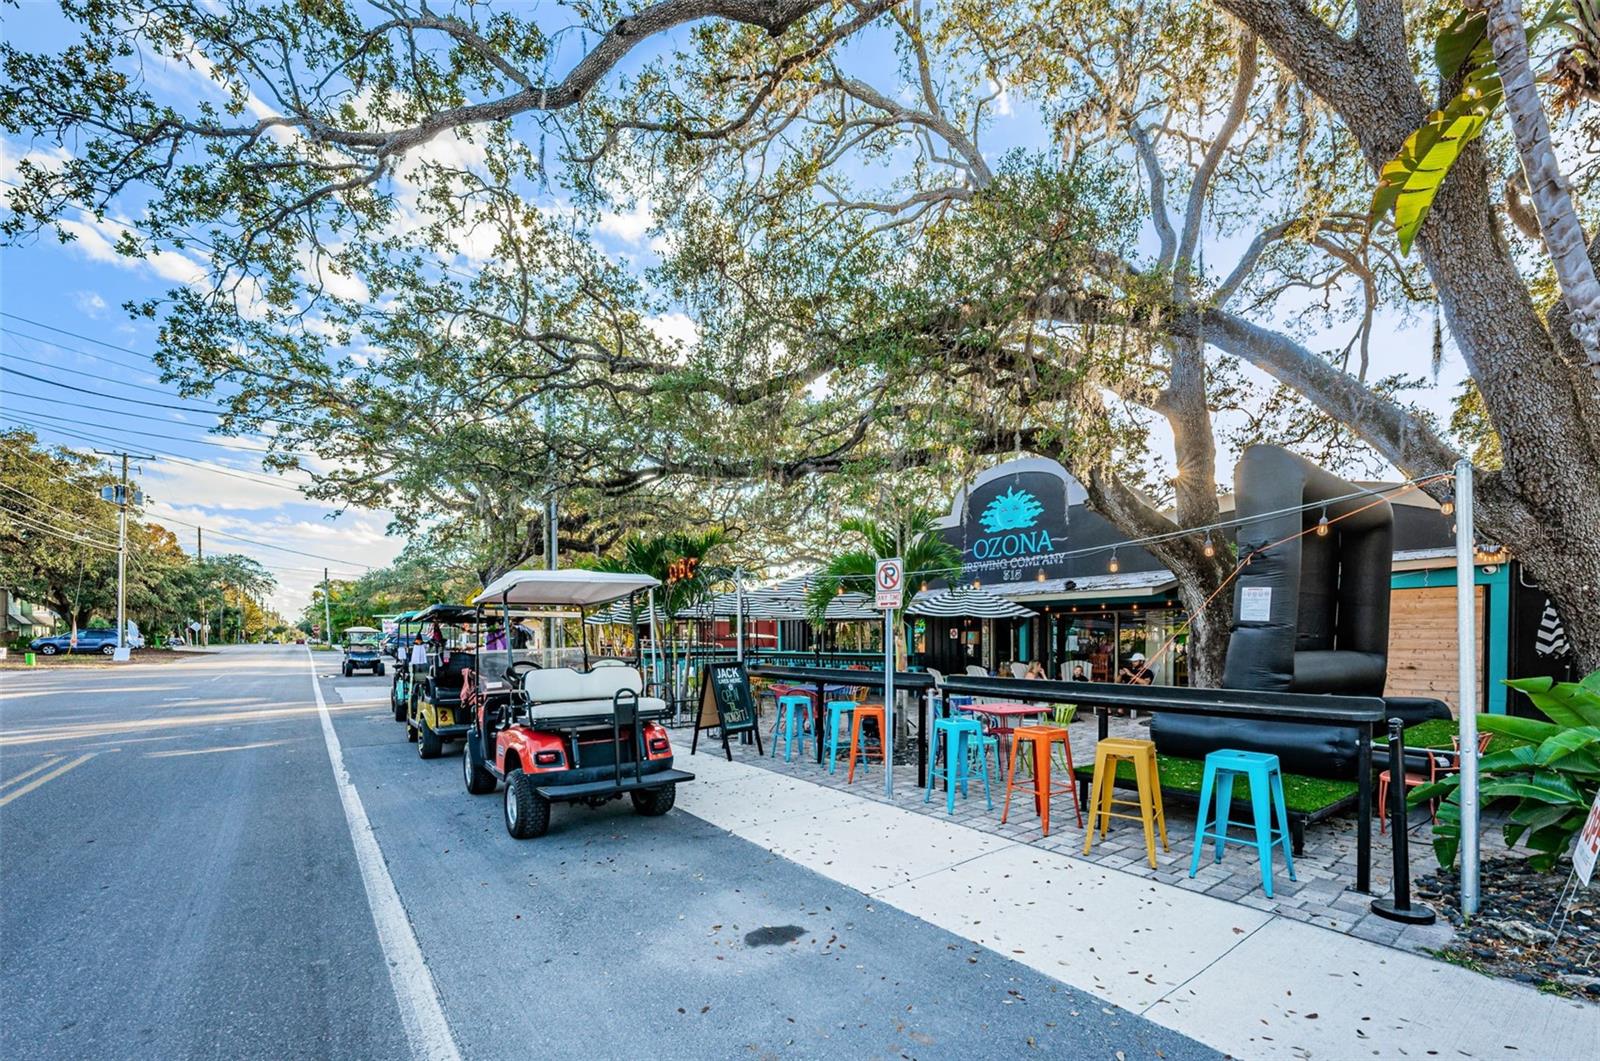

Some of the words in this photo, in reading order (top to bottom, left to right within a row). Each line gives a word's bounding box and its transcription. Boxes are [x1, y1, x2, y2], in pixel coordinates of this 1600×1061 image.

[973, 529, 1054, 560] OZONA
[961, 558, 1009, 574] BREWING
[1009, 552, 1065, 568] COMPANY
[717, 667, 739, 678] JACK
[721, 688, 739, 703] OPEN
